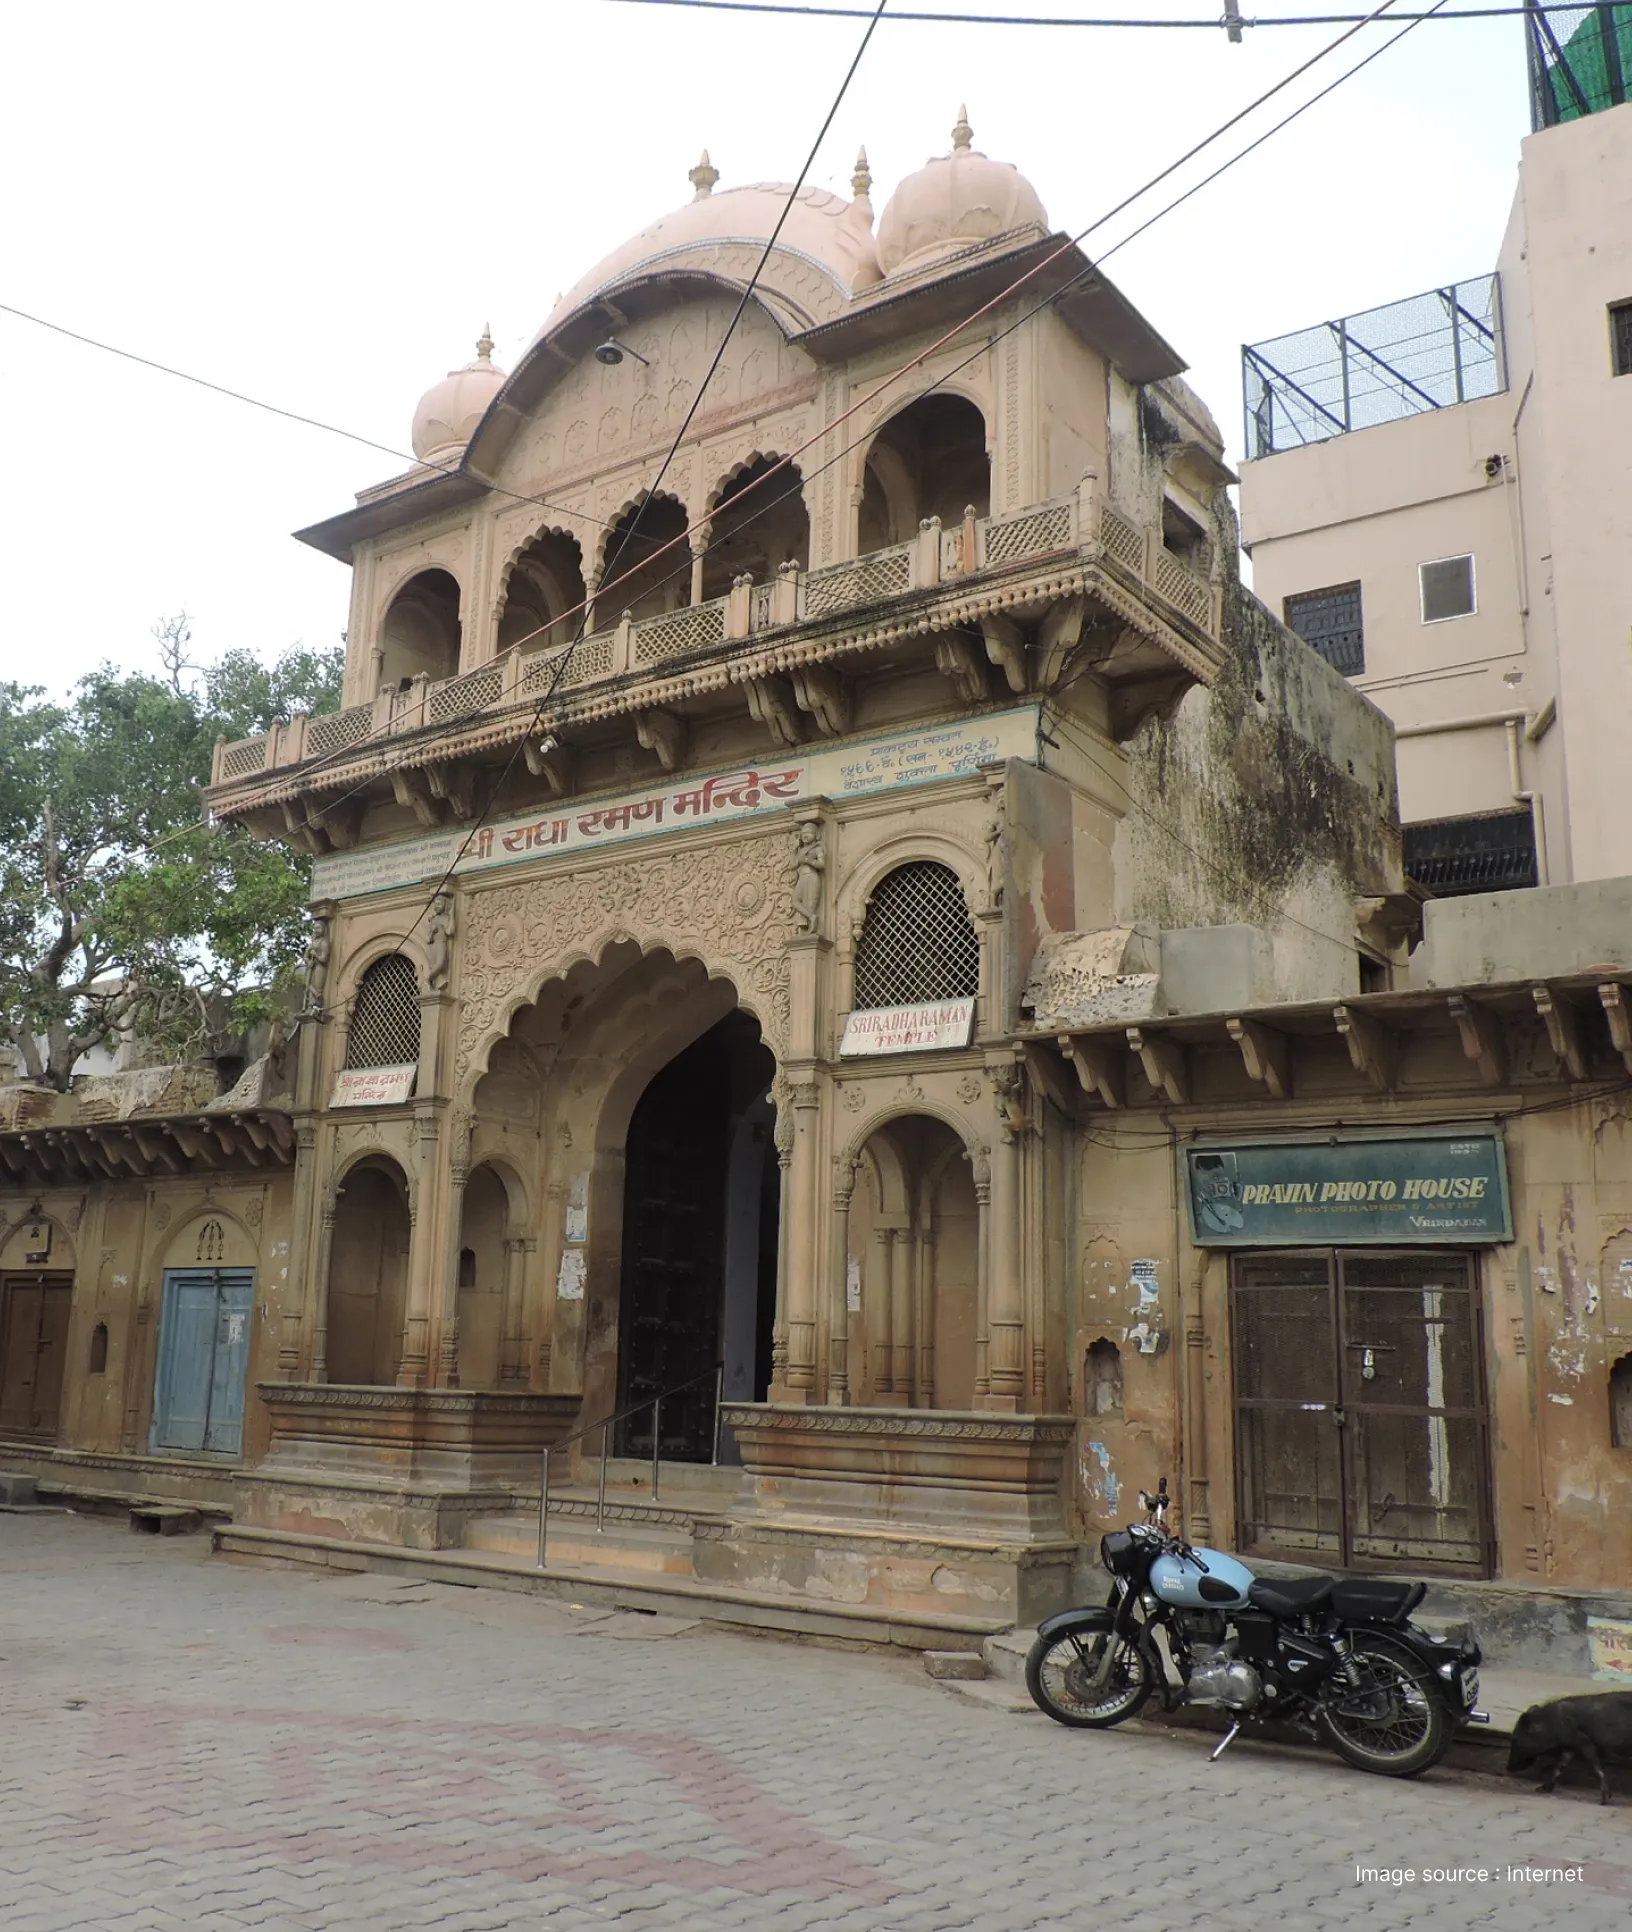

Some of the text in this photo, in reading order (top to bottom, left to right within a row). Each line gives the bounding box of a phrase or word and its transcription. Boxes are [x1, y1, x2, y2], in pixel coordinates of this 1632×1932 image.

[456, 768, 804, 860] श्री राधा रमण मन्दिर
[875, 1031, 938, 1048] TEMPLE
[1242, 1176, 1489, 1205] PRAVIN PHOTO HOUSE
[1295, 1203, 1407, 1214] PHOTOGRAPHER
[1426, 1201, 1479, 1210] ARTIST
